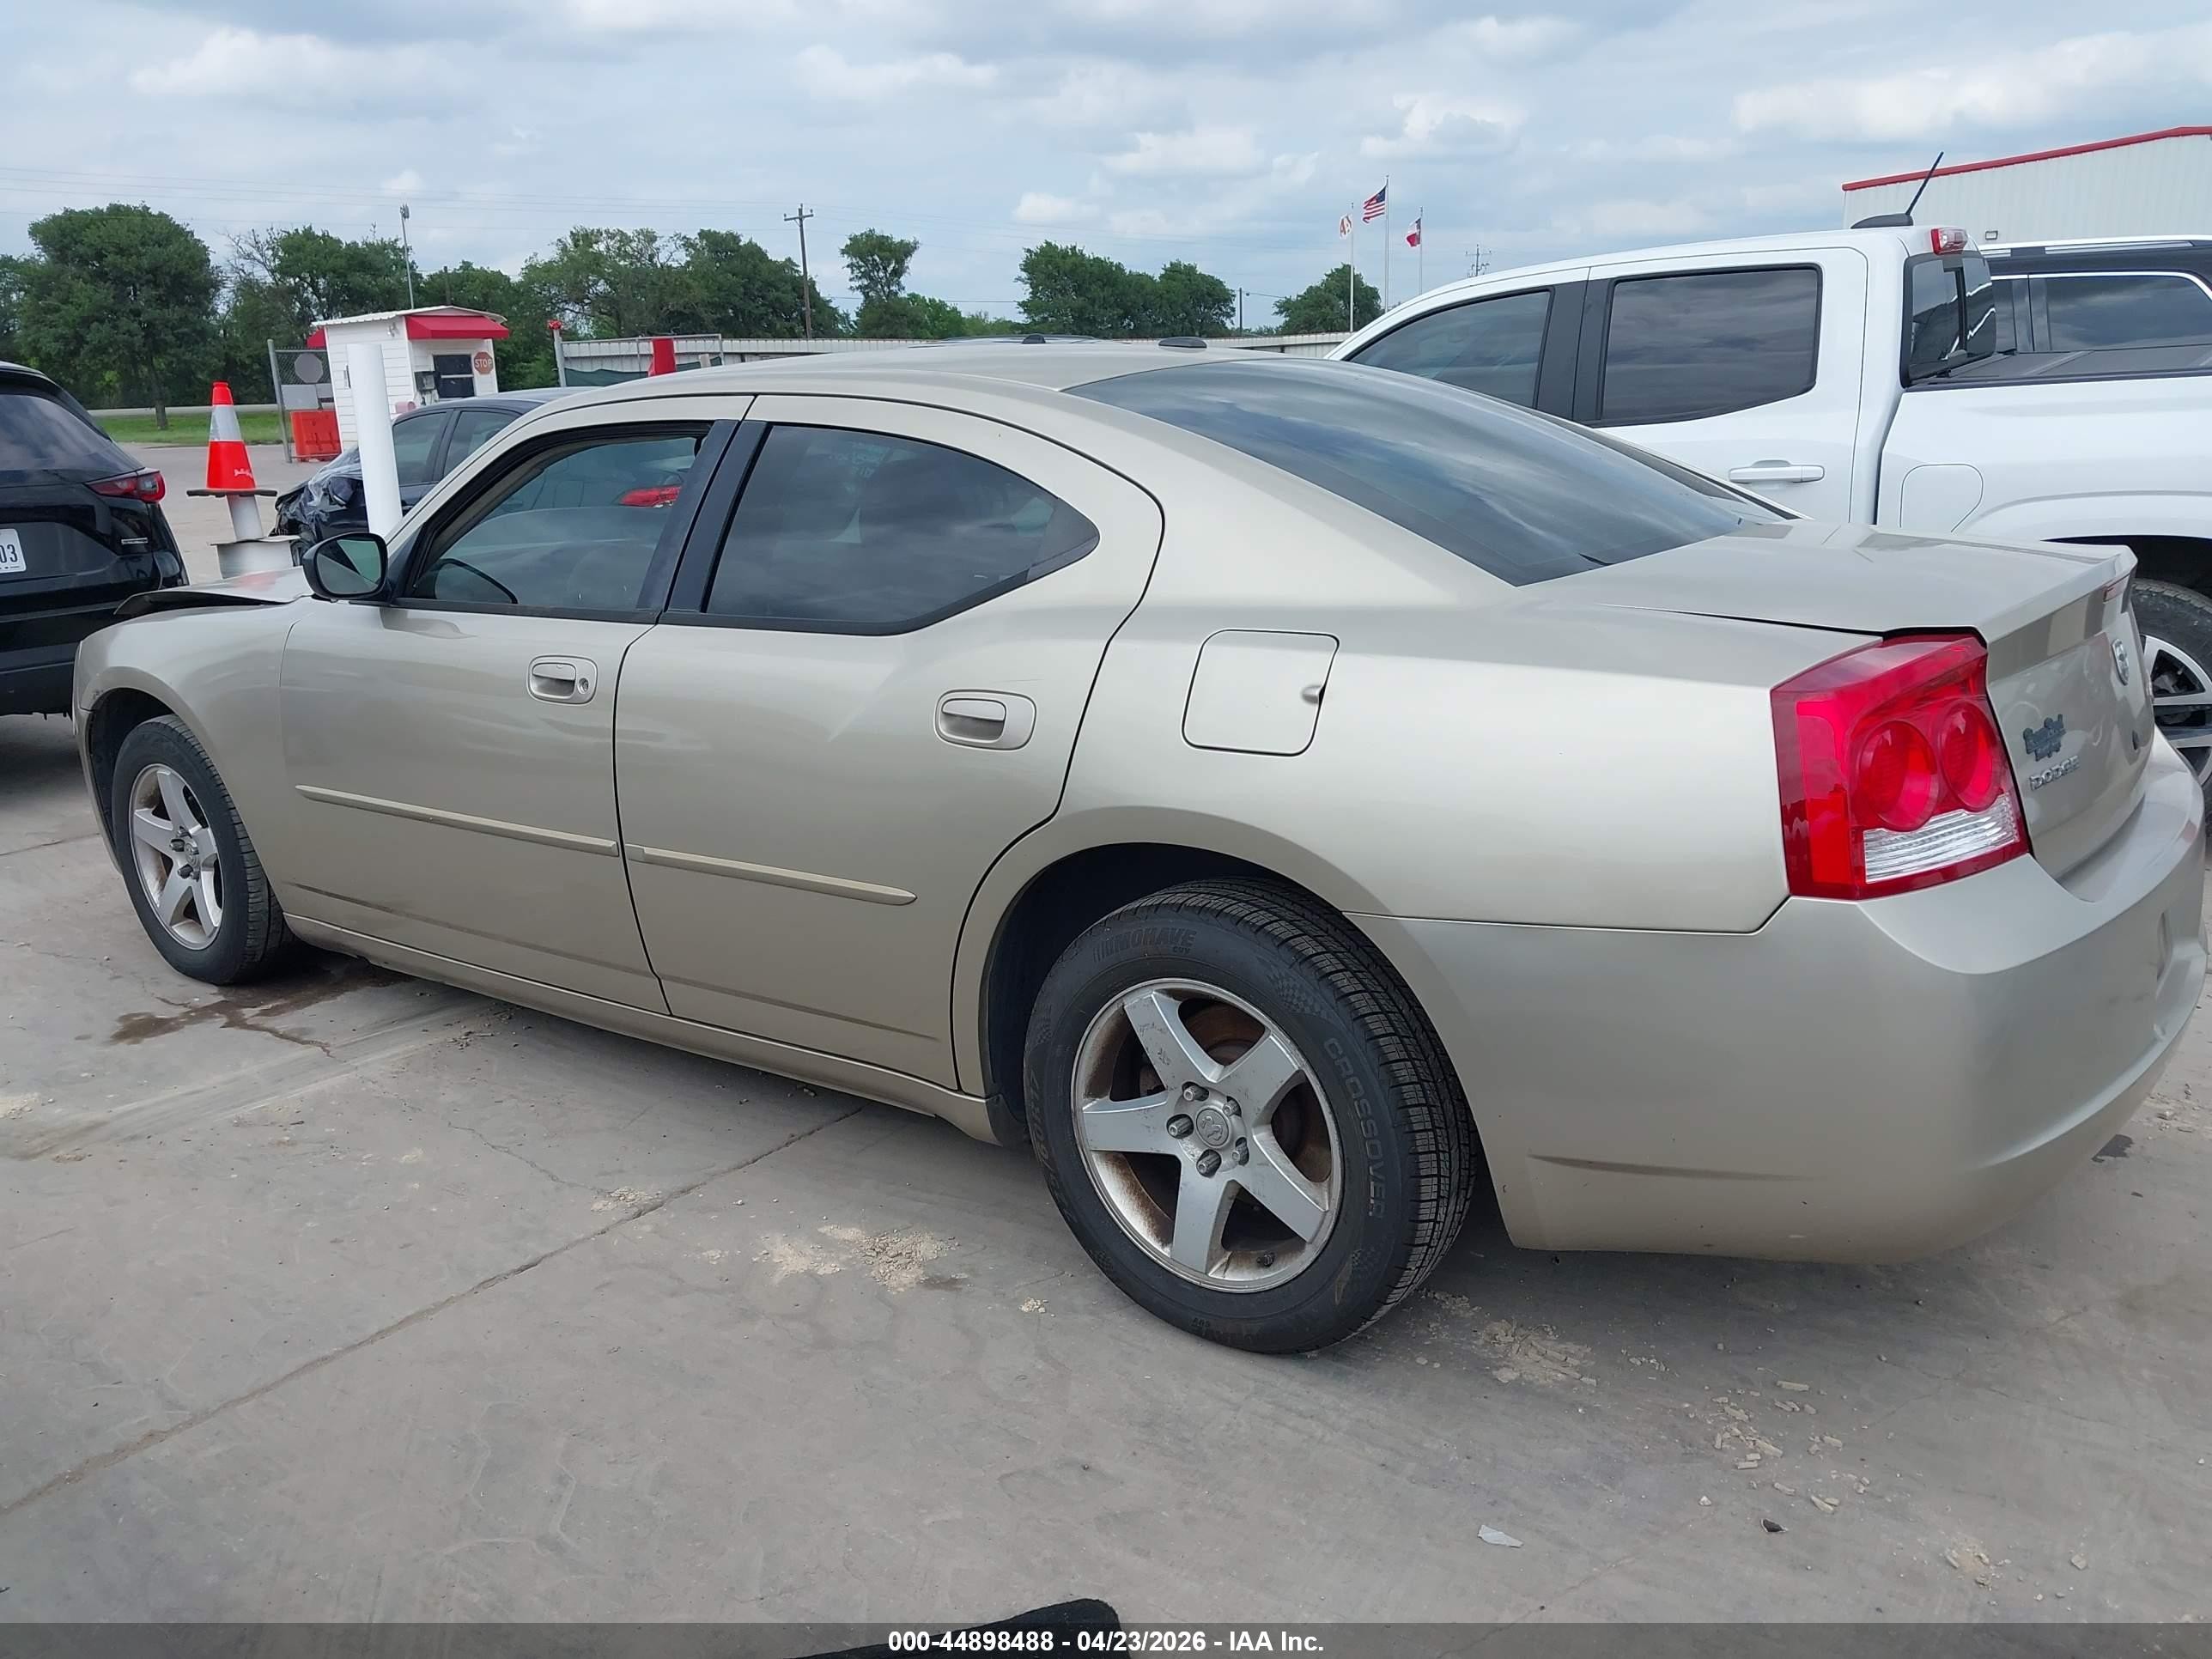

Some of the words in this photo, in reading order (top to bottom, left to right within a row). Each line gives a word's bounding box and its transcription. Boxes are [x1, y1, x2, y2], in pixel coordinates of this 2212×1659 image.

[475, 359, 492, 368] STOP
[2029, 756, 2079, 791] DODGE
[1324, 1037, 1386, 1218] CROSSOVER
